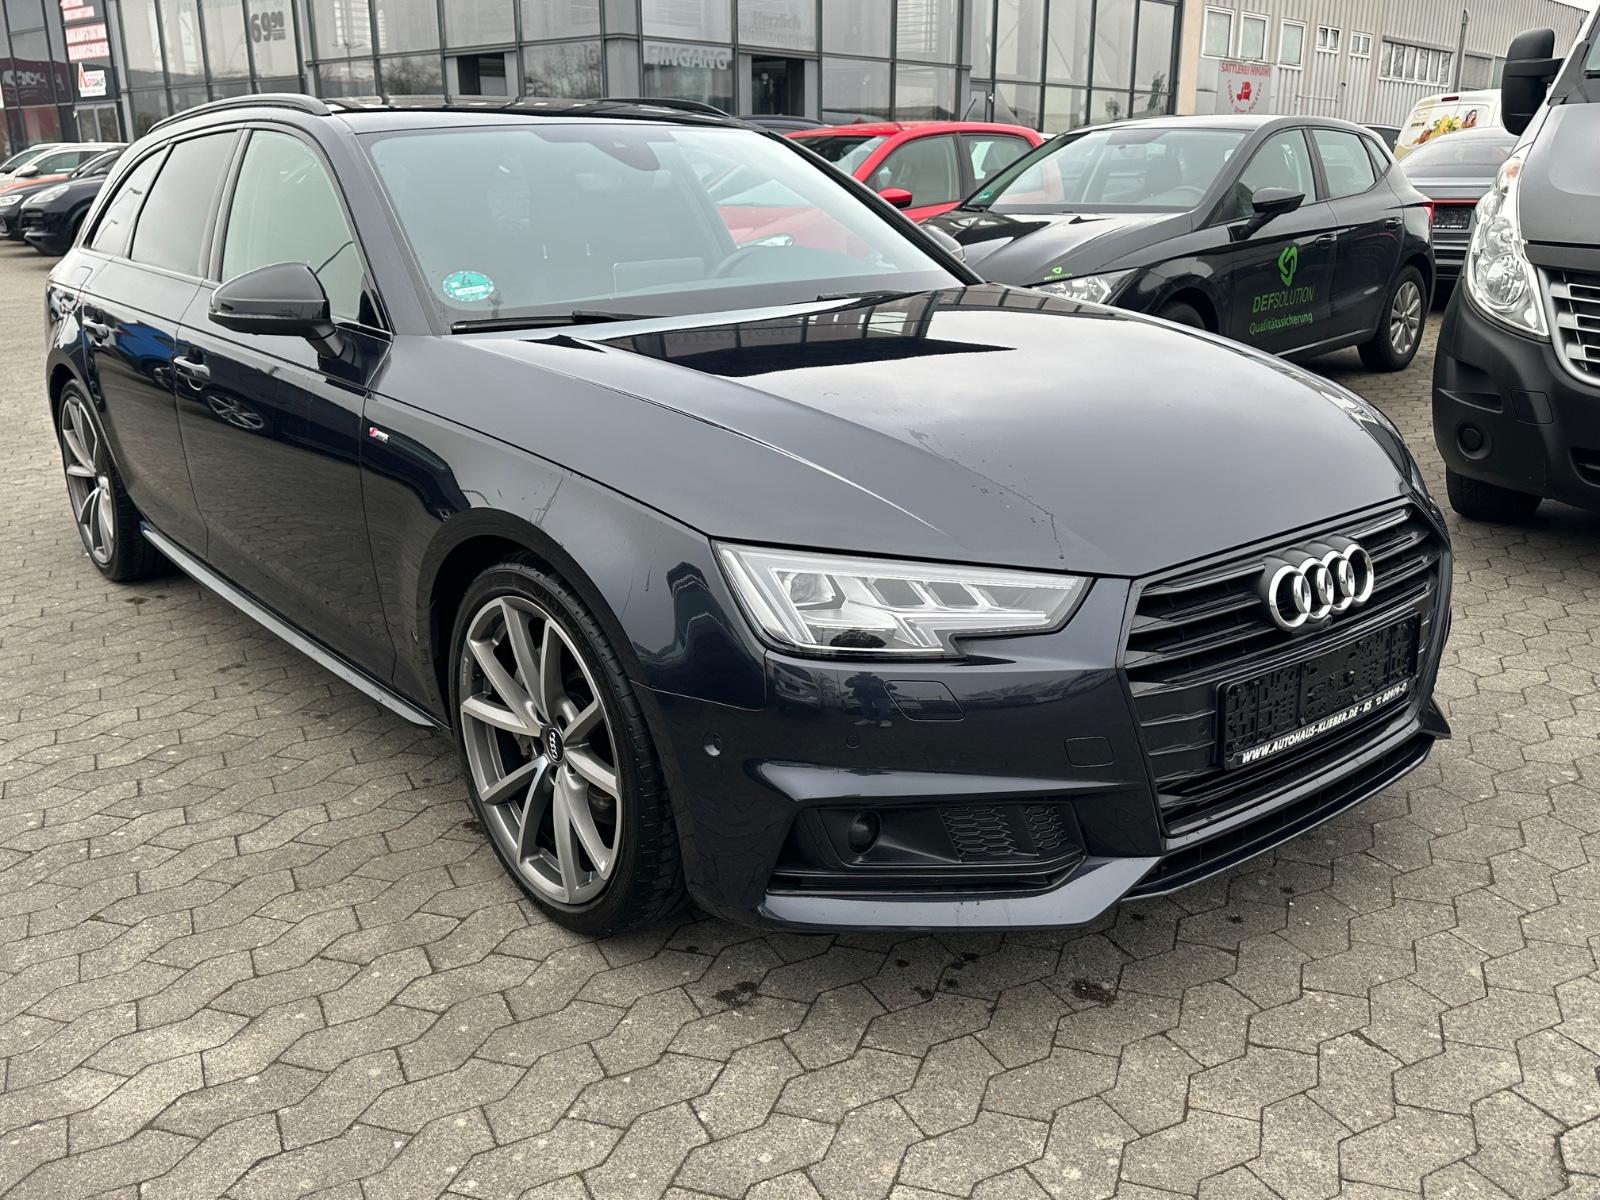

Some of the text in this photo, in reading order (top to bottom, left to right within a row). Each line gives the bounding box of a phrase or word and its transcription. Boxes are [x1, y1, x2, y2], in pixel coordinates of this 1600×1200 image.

[647, 45, 728, 70] EINGANG
[1252, 286, 1314, 313] DEFSOLUTION
[1249, 313, 1313, 335] Qualitätssicherung
